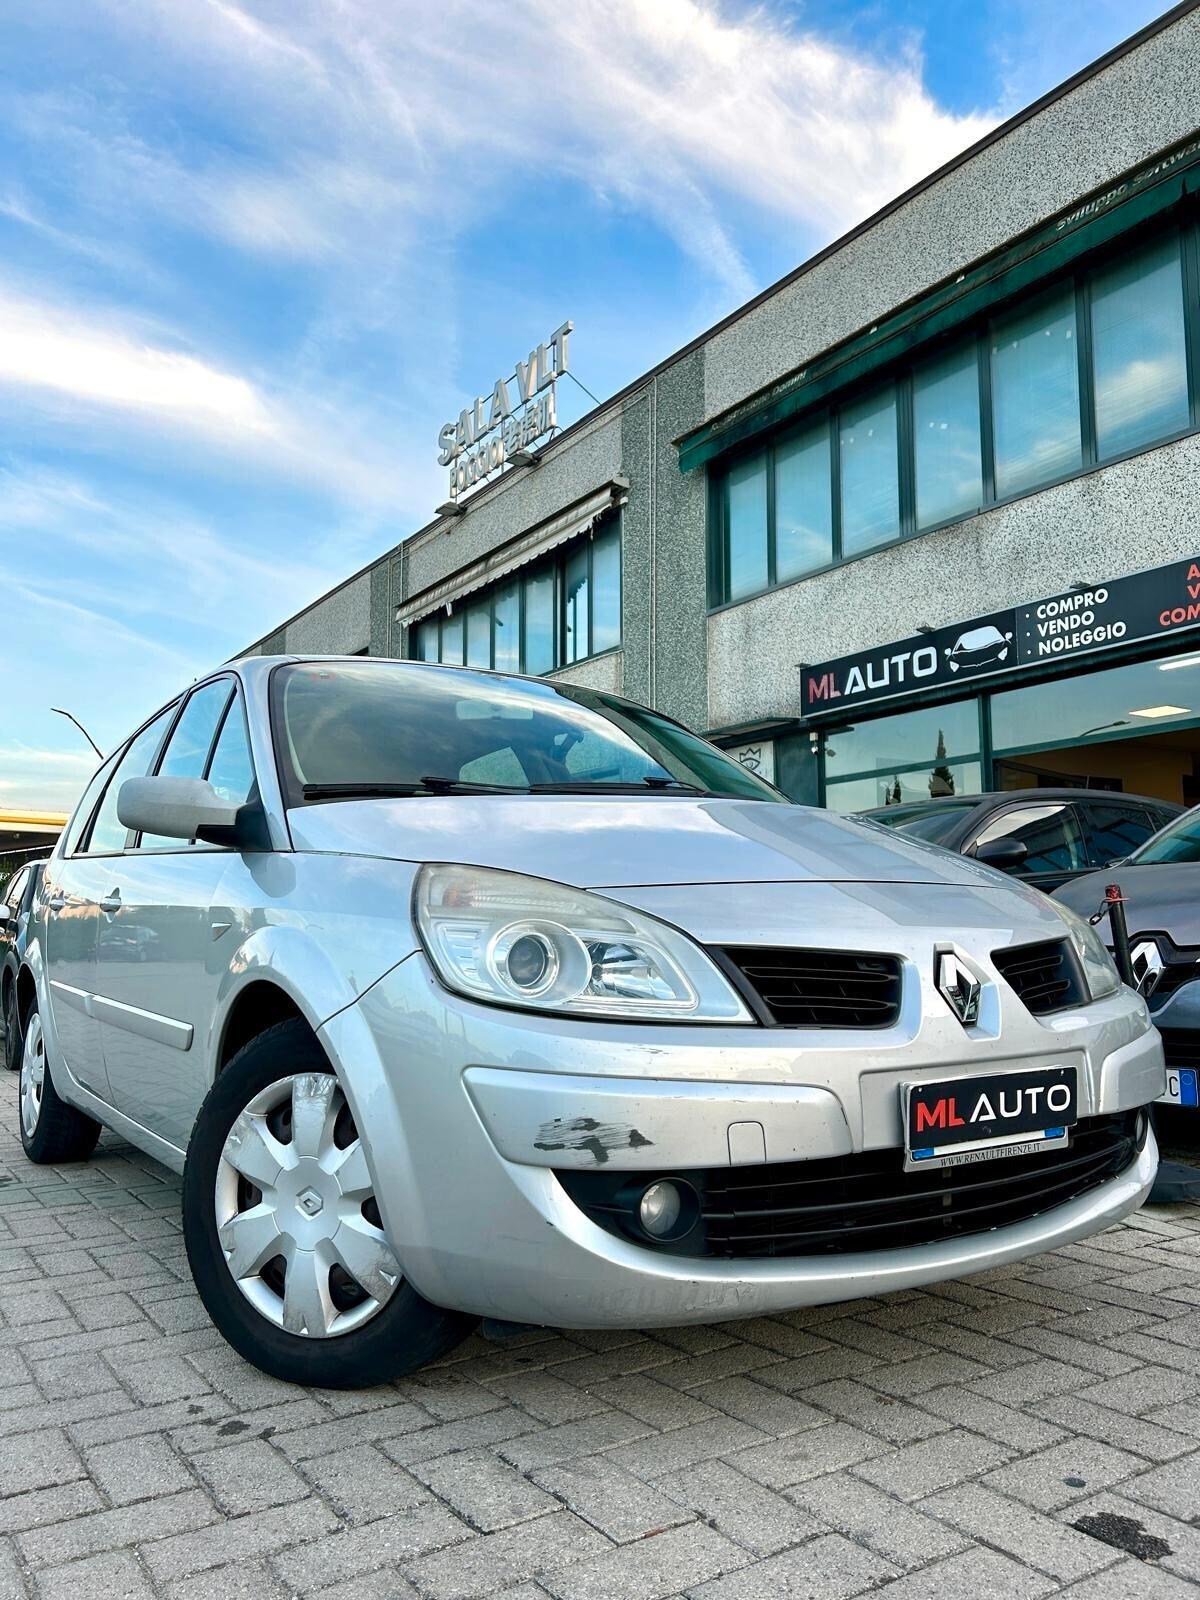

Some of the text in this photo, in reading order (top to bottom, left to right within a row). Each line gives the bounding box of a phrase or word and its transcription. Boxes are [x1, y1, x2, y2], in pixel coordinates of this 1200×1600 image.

[1056, 183, 1128, 231] Sviluppo
[438, 319, 574, 466] SALA VLT
[1036, 588, 1109, 620] COMPRO
[1037, 611, 1095, 637] VENDO
[1038, 621, 1127, 656] NOLEGGIO
[1169, 1076, 1179, 1097] C
